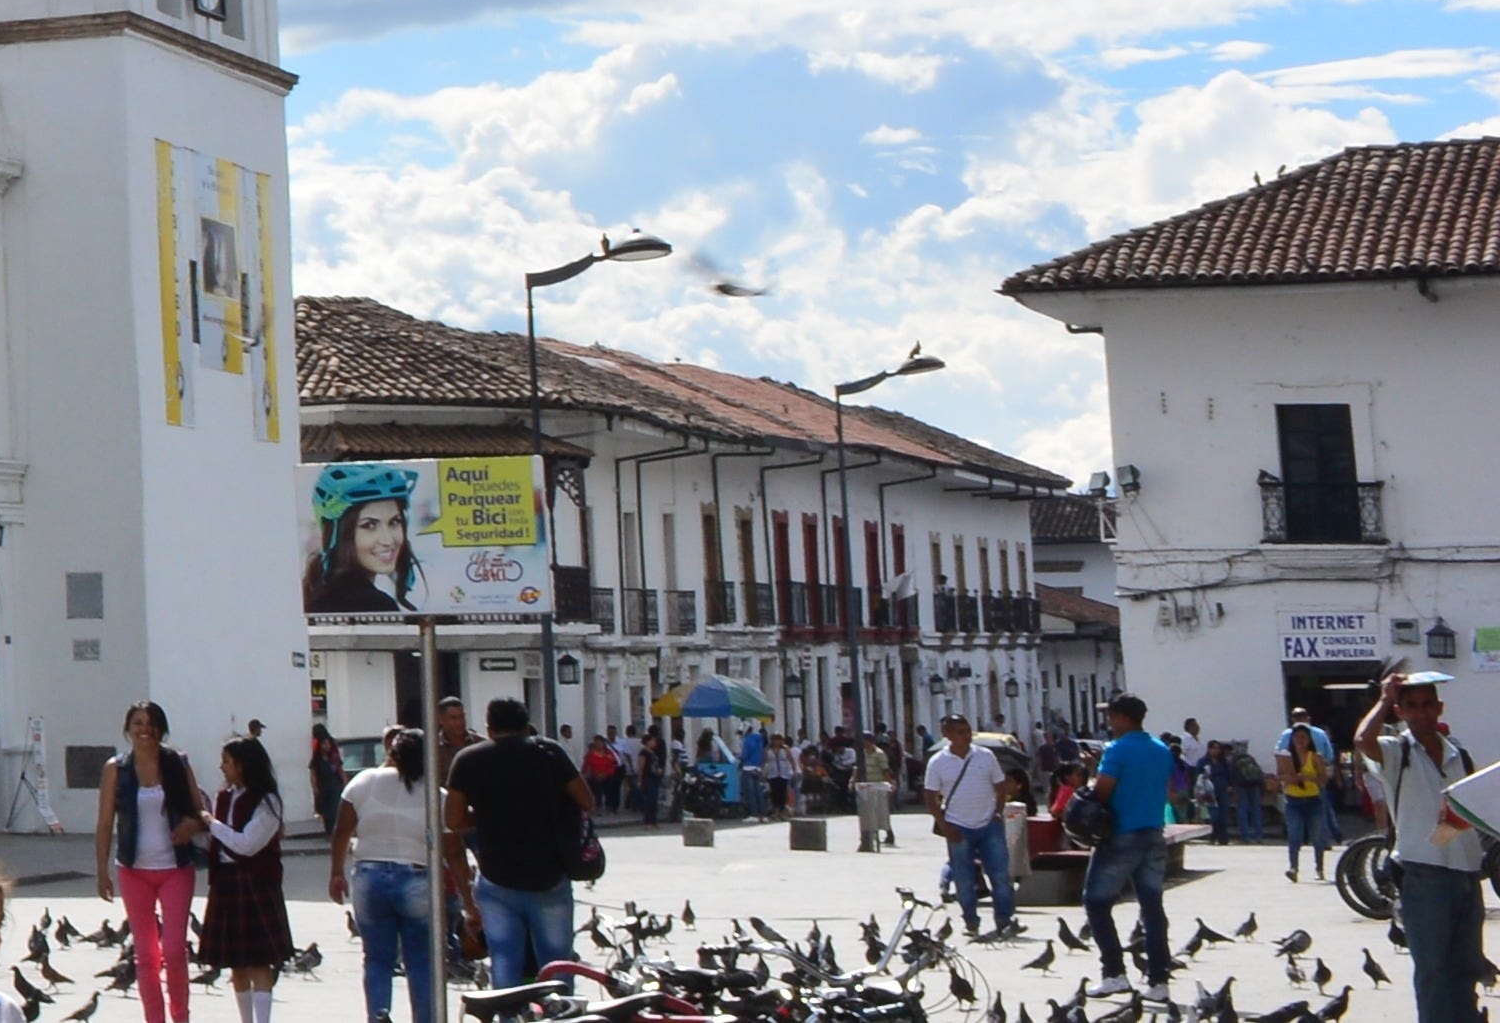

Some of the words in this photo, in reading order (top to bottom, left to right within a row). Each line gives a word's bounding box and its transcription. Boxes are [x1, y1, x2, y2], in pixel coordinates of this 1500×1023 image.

[448, 492, 521, 509] Parquear
[456, 516, 468, 526] tu
[473, 508, 506, 526] Bici
[1291, 615, 1365, 630] INTERNET
[1284, 637, 1320, 658] FAX
[1322, 636, 1377, 645] CONSULTAS
[1325, 649, 1375, 658] PAPELERIA
